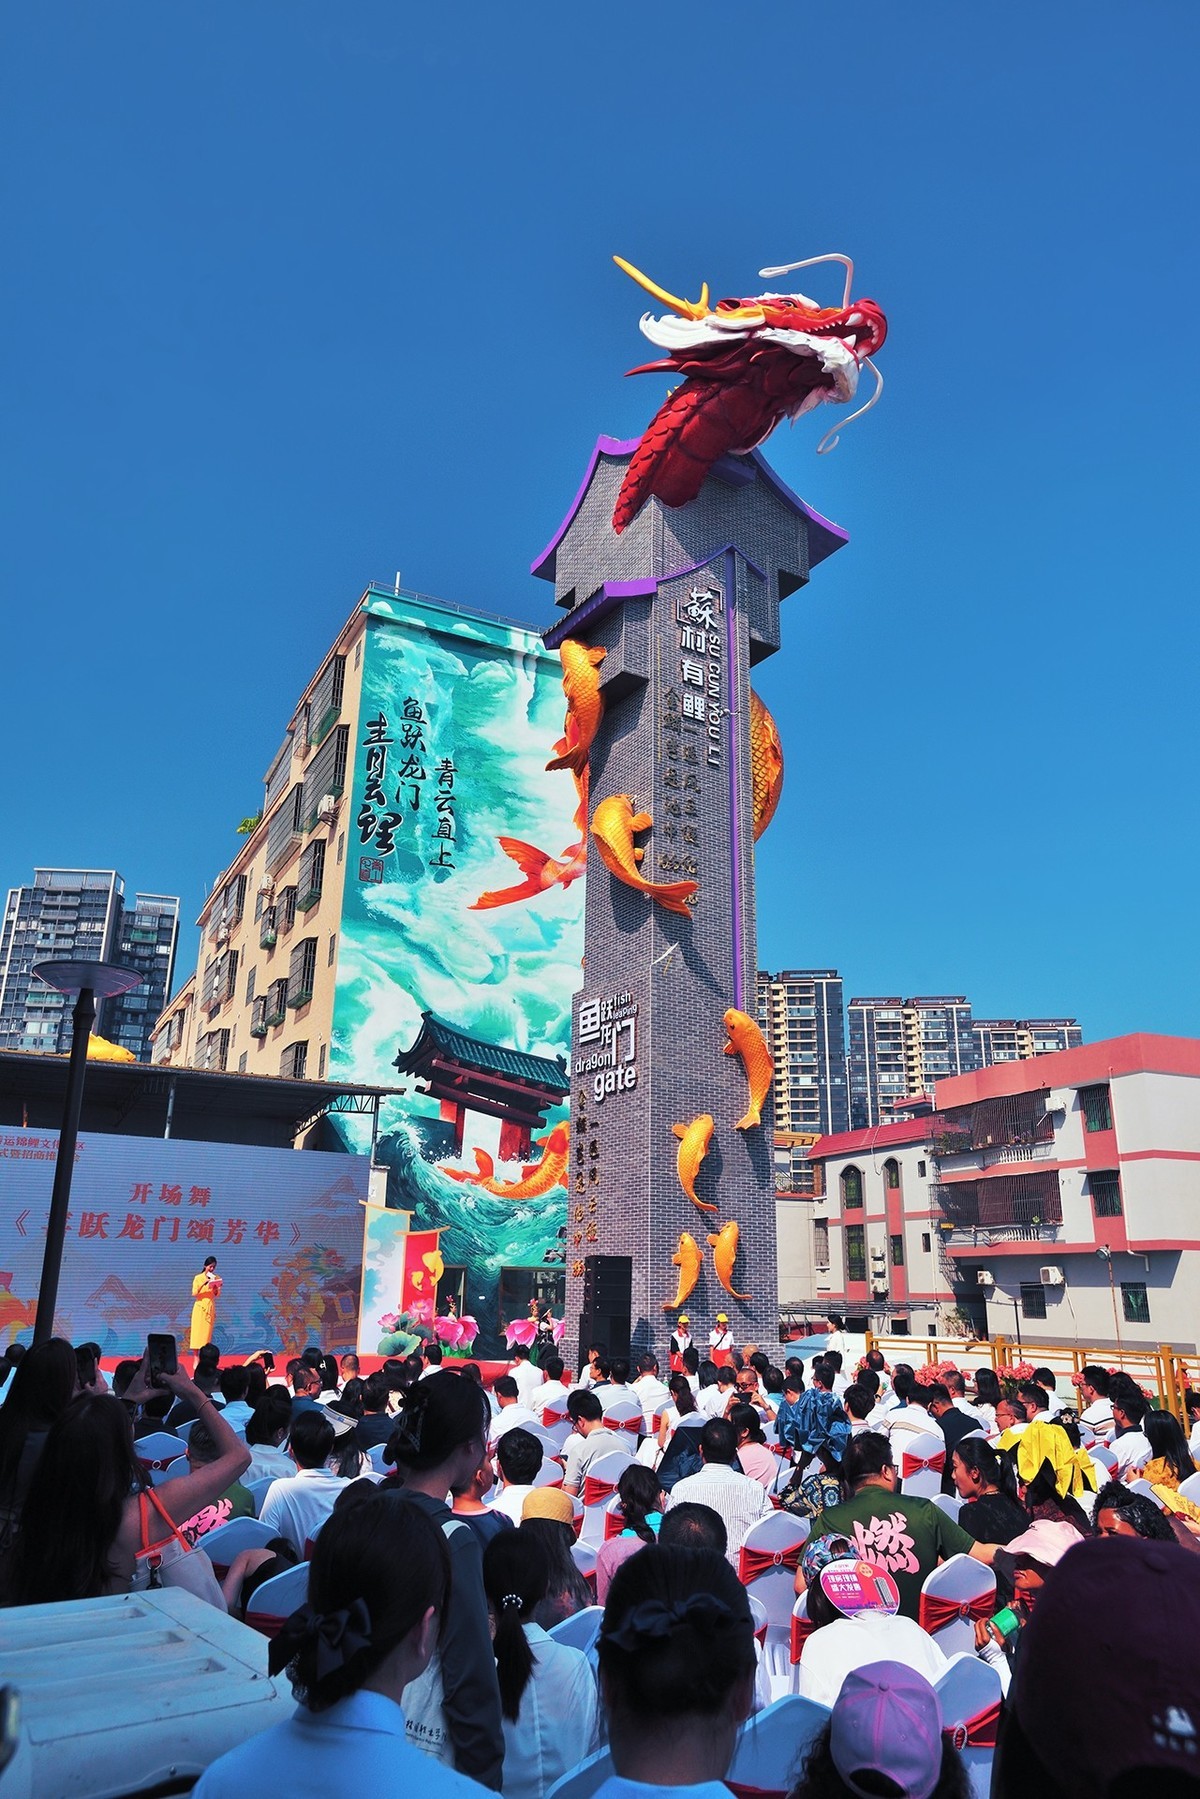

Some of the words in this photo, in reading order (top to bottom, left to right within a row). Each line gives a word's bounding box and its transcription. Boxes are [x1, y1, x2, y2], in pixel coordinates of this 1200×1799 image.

[708, 631, 720, 658] SU
[708, 662, 720, 696] CUN
[708, 701, 721, 739] YOU
[395, 696, 427, 811] 鱼跃龙门
[707, 745, 720, 766] LI
[429, 757, 458, 869] 青云直上
[614, 990, 631, 1006] fish
[575, 1053, 611, 1073] dragon
[594, 1065, 636, 1102] gate
[128, 1182, 211, 1207] 开场舞
